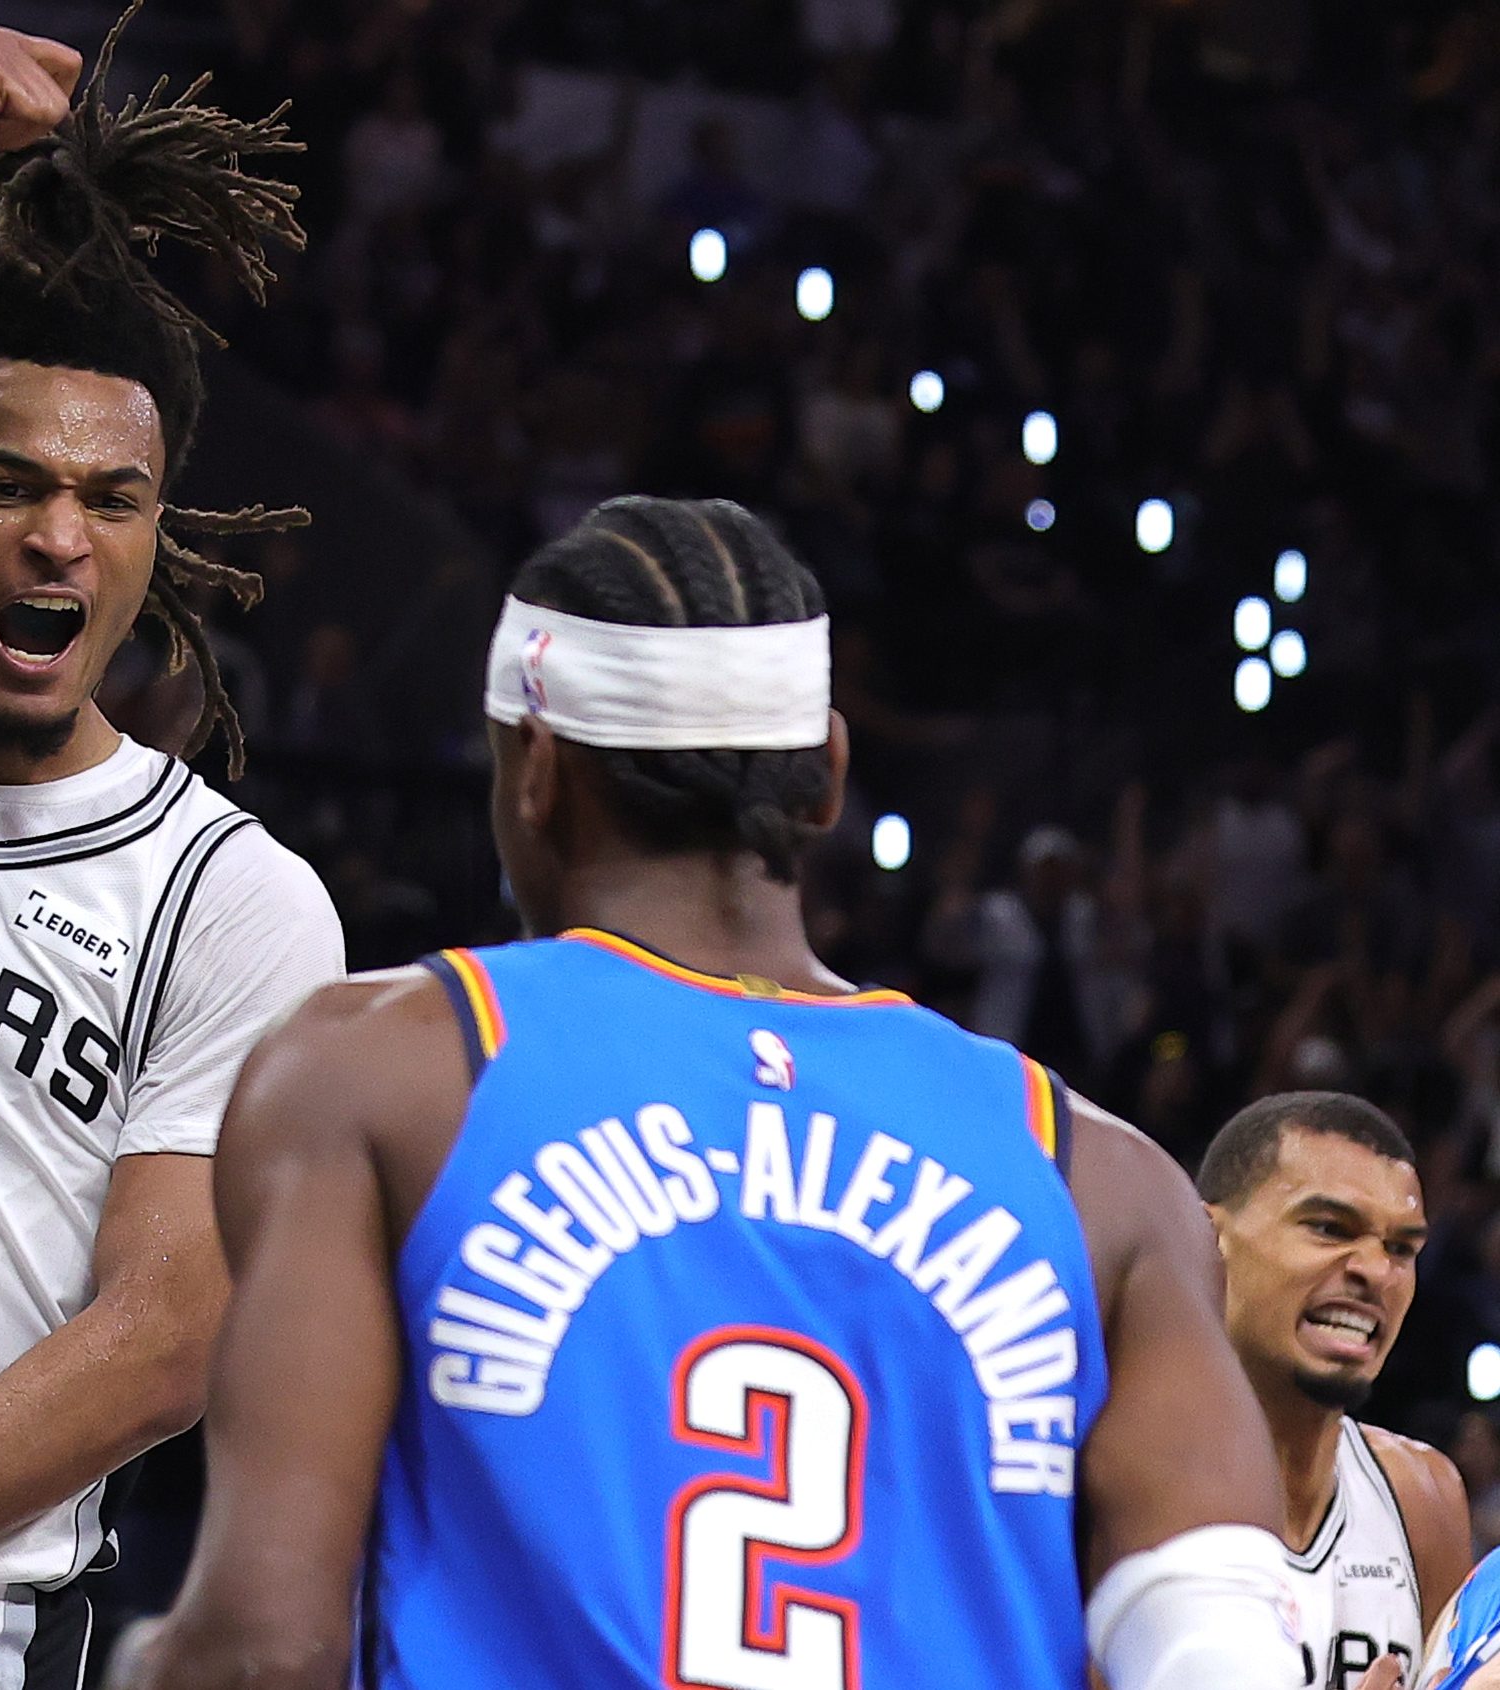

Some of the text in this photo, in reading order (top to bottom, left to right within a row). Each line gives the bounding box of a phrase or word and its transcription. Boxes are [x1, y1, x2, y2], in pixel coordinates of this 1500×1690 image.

[32, 906, 113, 959] LEDGER
[428, 1101, 1078, 1498] GILGEOUS-ALEXANDER
[666, 1324, 869, 1690] 2
[1343, 1564, 1395, 1579] LEDGER
